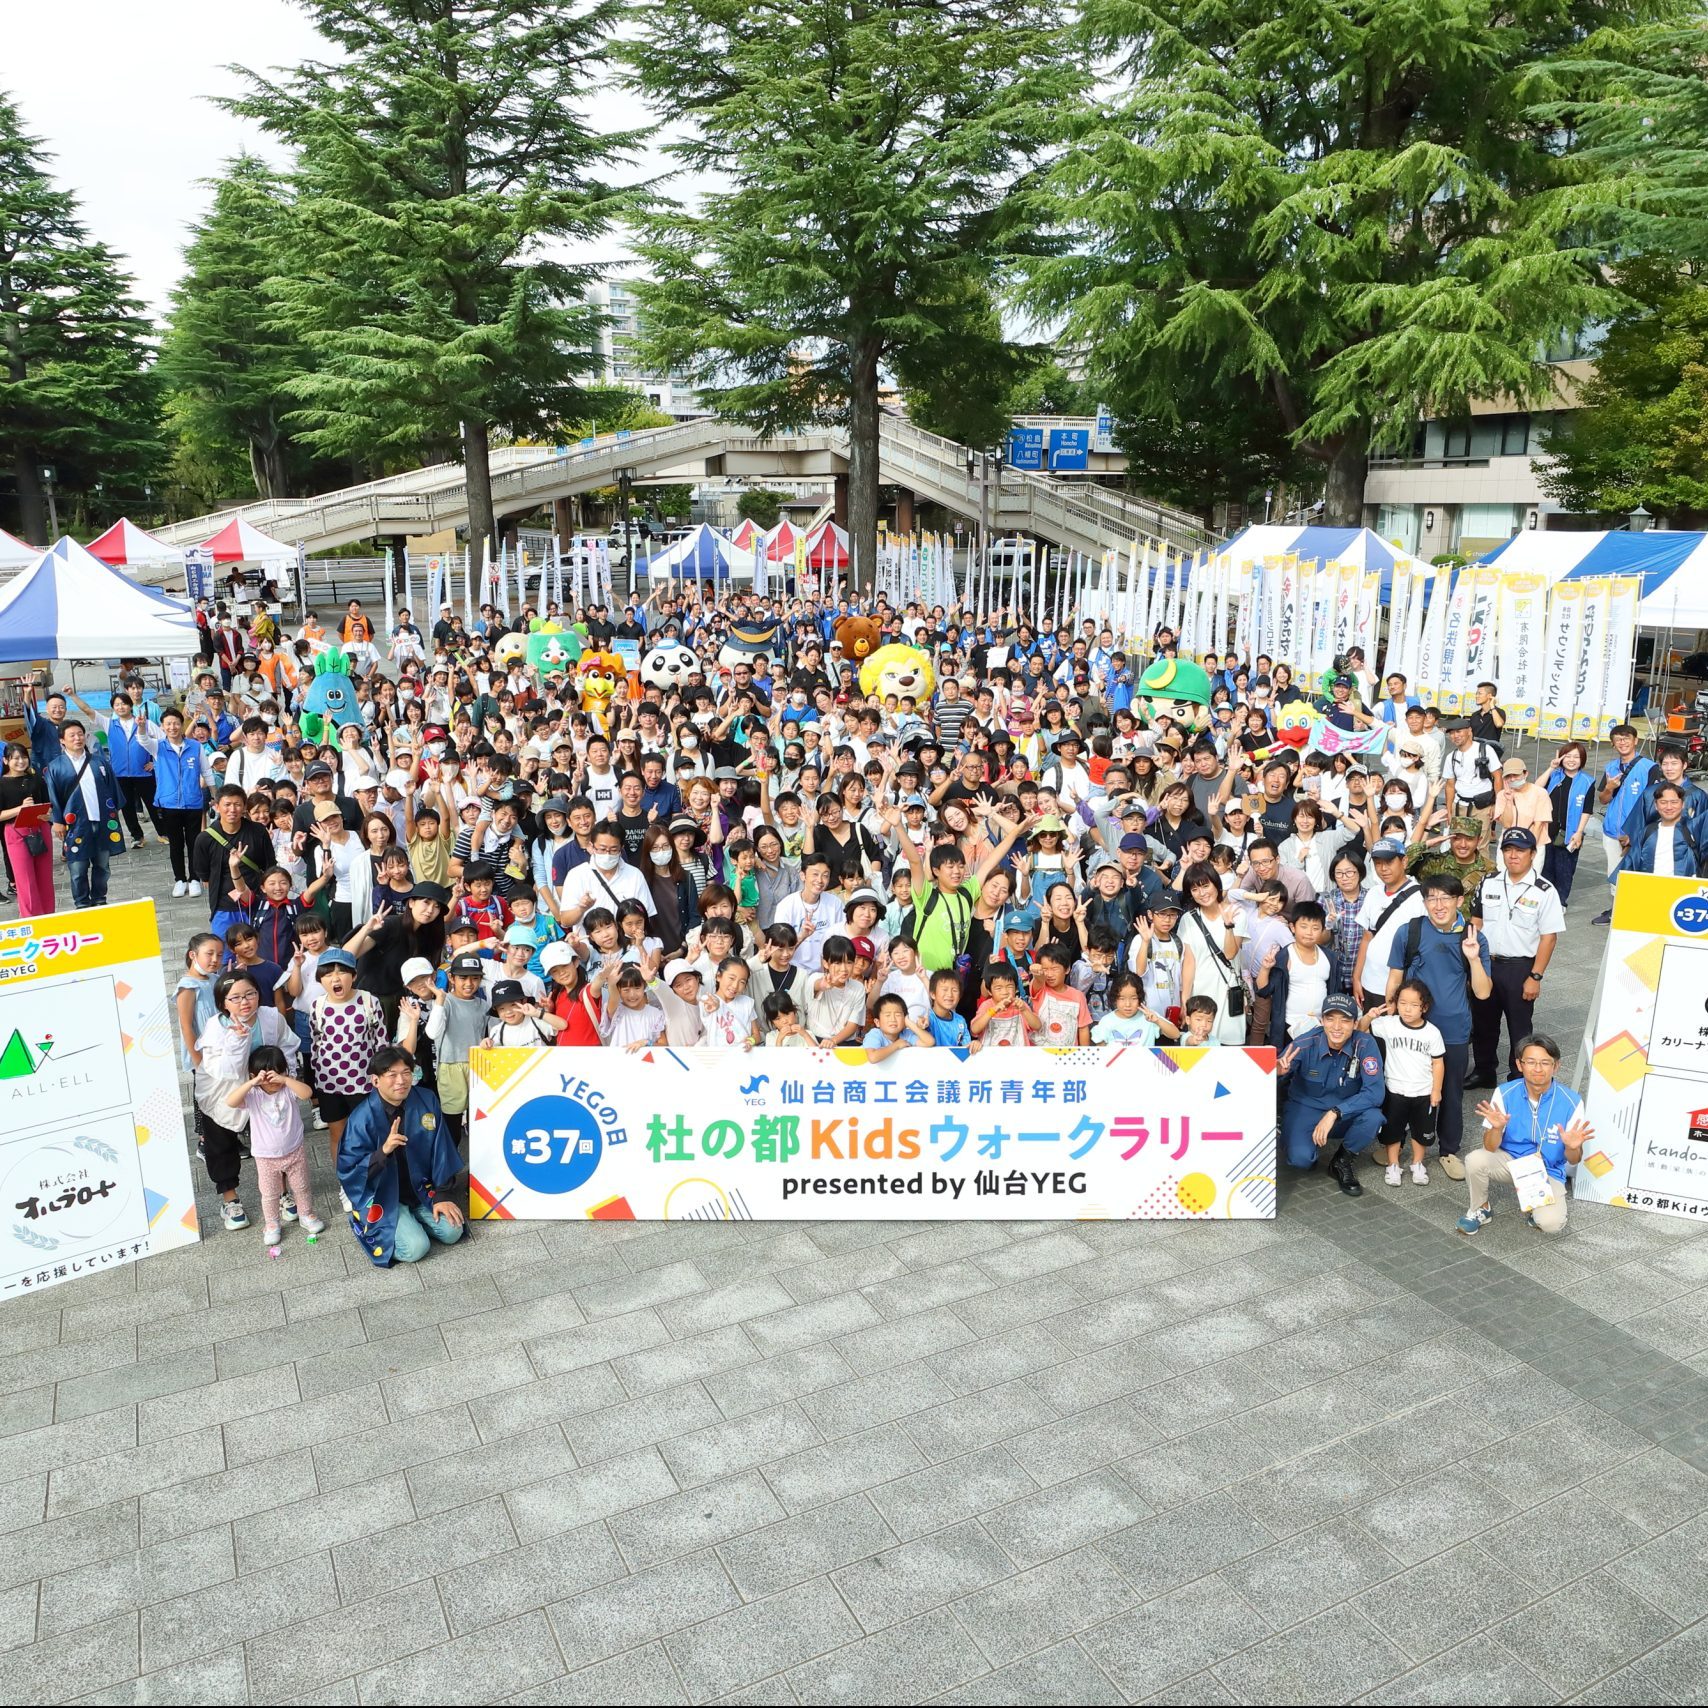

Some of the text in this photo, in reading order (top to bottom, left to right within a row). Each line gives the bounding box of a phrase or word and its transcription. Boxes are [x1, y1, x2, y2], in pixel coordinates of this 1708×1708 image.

[744, 1098, 767, 1106] YEG
[780, 1079, 1087, 1104] 仙台商工会議所青年部
[559, 1073, 628, 1147] YEGの日
[645, 1113, 1243, 1164] 杜の都Kidsウォークラリー
[40, 1169, 89, 1190] 株式会社
[782, 1169, 1087, 1201] presented by 仙台YEG
